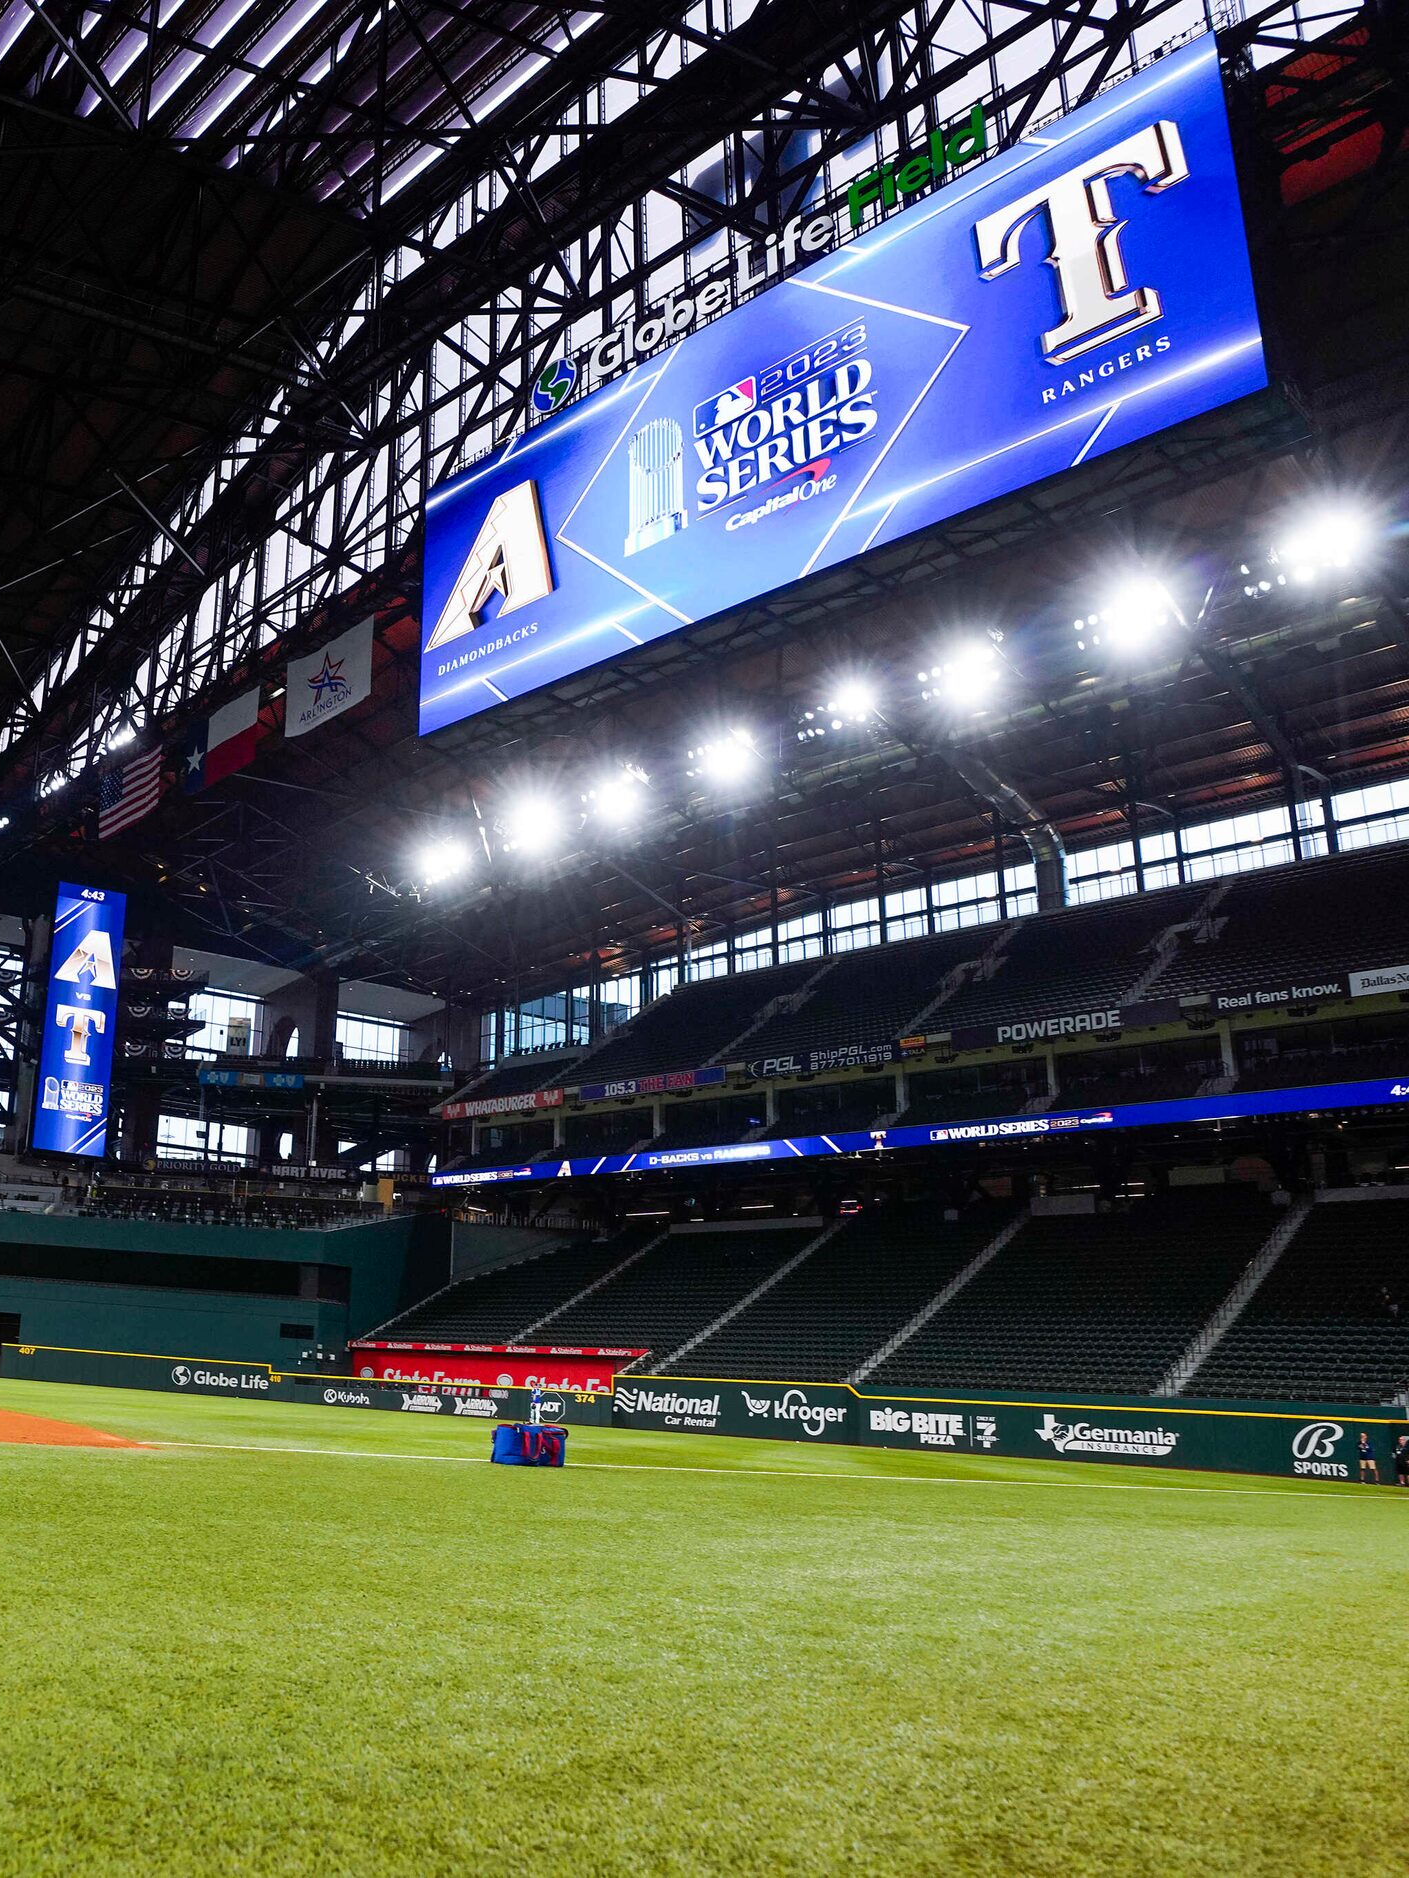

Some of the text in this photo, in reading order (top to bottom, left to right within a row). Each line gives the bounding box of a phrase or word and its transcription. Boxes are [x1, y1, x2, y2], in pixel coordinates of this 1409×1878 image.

[590, 102, 988, 376] Globe Life Field
[971, 120, 1190, 366] T
[760, 324, 868, 397] 2023
[1042, 336, 1171, 404] RANGERS
[694, 358, 872, 469] WORLD
[697, 393, 878, 512] SERIES
[424, 480, 554, 654] A
[437, 623, 538, 677] DIAMONDBACKS
[299, 686, 352, 723] ARLINGTON
[81, 888, 105, 902] 4:43
[54, 929, 117, 990] A
[1217, 983, 1342, 1009] Real fans know.
[997, 1010, 1121, 1043] POWERADE
[810, 1044, 892, 1062] ShipPGL.com
[810, 1051, 892, 1071] 877.701.1919
[762, 1055, 802, 1074] PGL
[604, 1072, 695, 1096] 105.3 THE FAN
[60, 1099, 103, 1115] SERIES
[61, 1090, 103, 1104] WORLD
[465, 1094, 536, 1116] WHATABURGER
[948, 1128, 999, 1140] WORLD
[999, 1119, 1051, 1135] SERIES
[1050, 1118, 1079, 1129] 2023
[156, 1159, 241, 1174] PRIORITY GOLD
[649, 1152, 700, 1165] D-BACKS
[272, 1165, 346, 1180] HART HVAC
[19, 1347, 35, 1355] 407
[194, 1370, 269, 1390] Globe Life
[269, 1375, 282, 1383] 410
[585, 1378, 611, 1393] Fa
[338, 1391, 370, 1405] Kubota
[412, 1394, 438, 1406] ARROW
[465, 1398, 494, 1410] ARROW
[540, 1402, 561, 1412] ADT
[575, 1394, 596, 1404] 374
[637, 1391, 718, 1416] National
[664, 1415, 716, 1428] Car Rental
[774, 1389, 847, 1436] Kroger
[912, 1412, 963, 1436] BITE
[920, 1433, 955, 1446] PIZZA
[1071, 1422, 1177, 1447] Germania
[1081, 1442, 1158, 1455] INSURANCE
[1294, 1460, 1348, 1478] SPORTS
